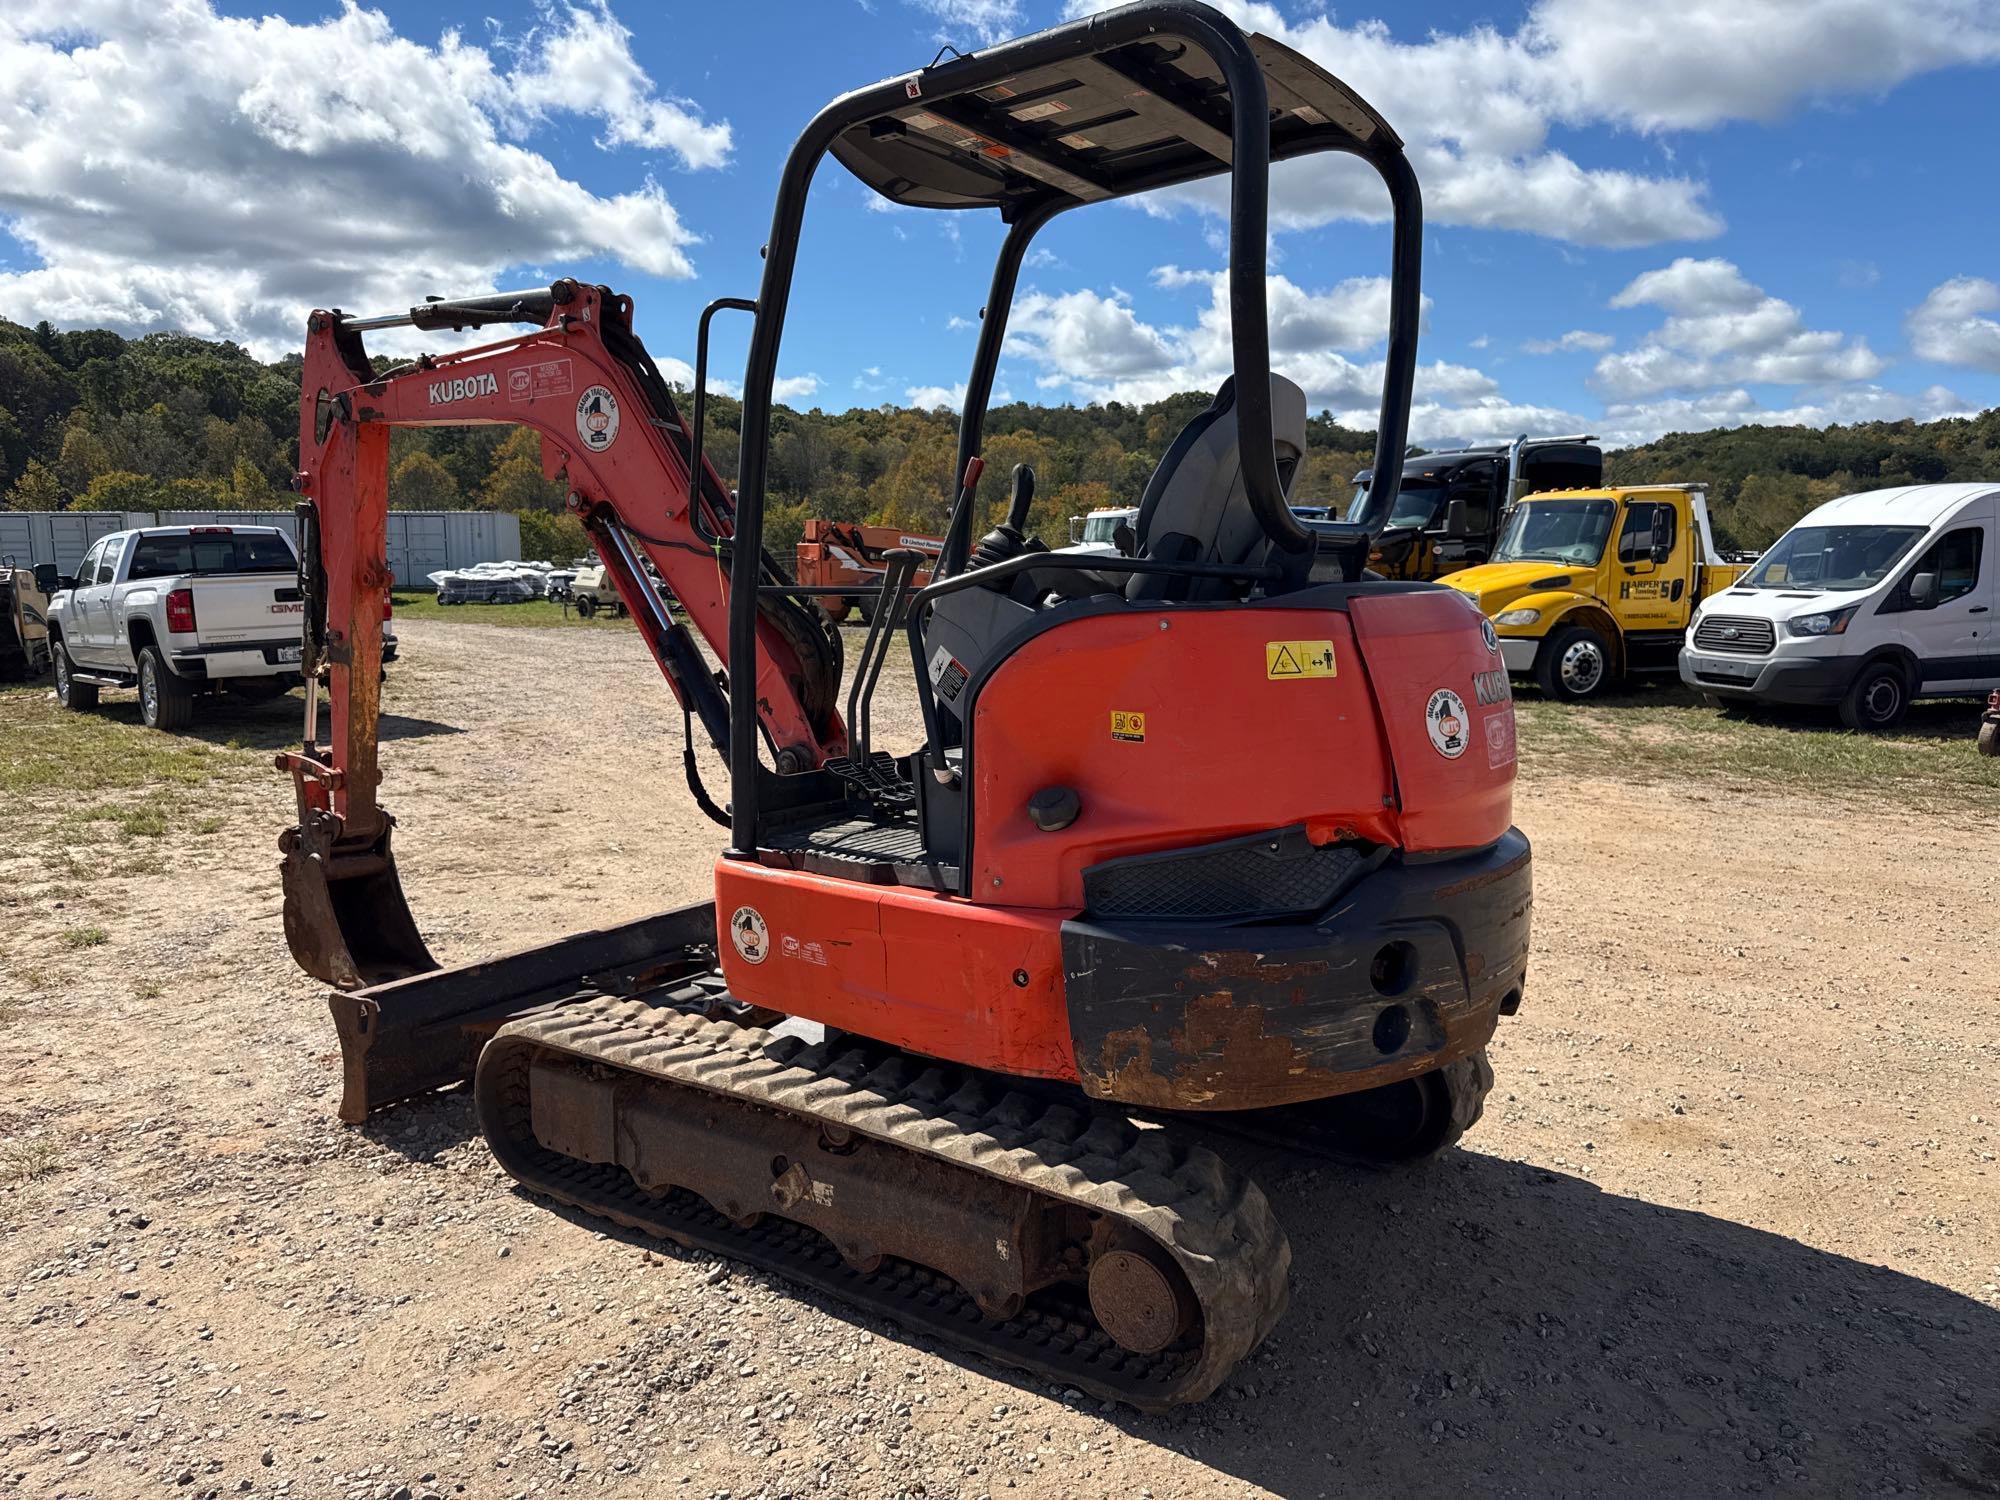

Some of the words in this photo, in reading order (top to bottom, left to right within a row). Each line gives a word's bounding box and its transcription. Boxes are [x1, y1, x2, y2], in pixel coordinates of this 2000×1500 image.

[429, 373, 499, 404] KUBOTA
[578, 392, 591, 414] MASON
[591, 387, 612, 401] TRACTOR
[909, 539, 925, 547] United
[1472, 670, 1512, 706] KUBO
[1427, 695, 1440, 719] MASON
[1437, 691, 1459, 704] TRACTOR
[742, 908, 761, 923] TRACTOR
